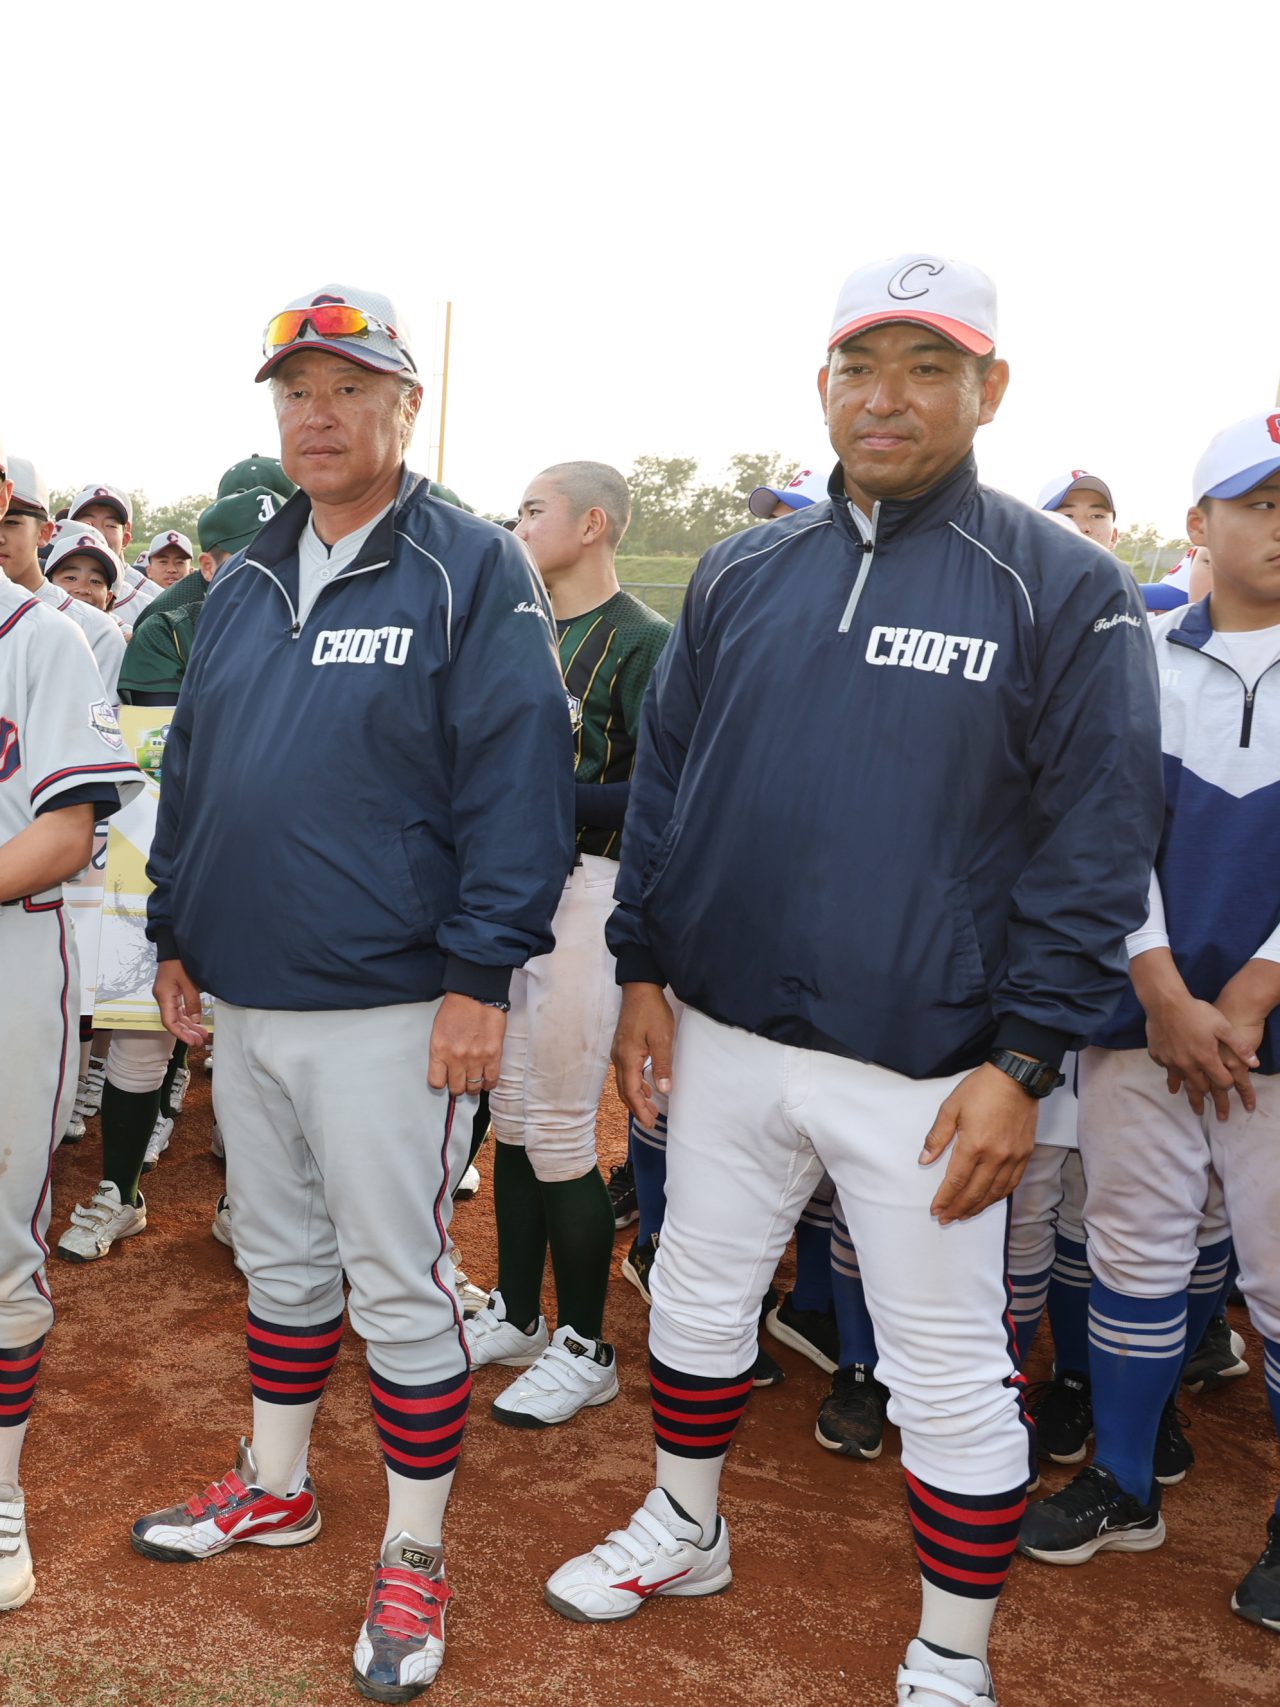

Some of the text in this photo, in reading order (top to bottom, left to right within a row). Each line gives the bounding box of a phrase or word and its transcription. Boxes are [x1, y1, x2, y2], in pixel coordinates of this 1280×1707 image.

[887, 258, 945, 300] C
[311, 626, 414, 666] CHOFU
[865, 625, 999, 682] CHOFU
[403, 1550, 433, 1566] ZETT
